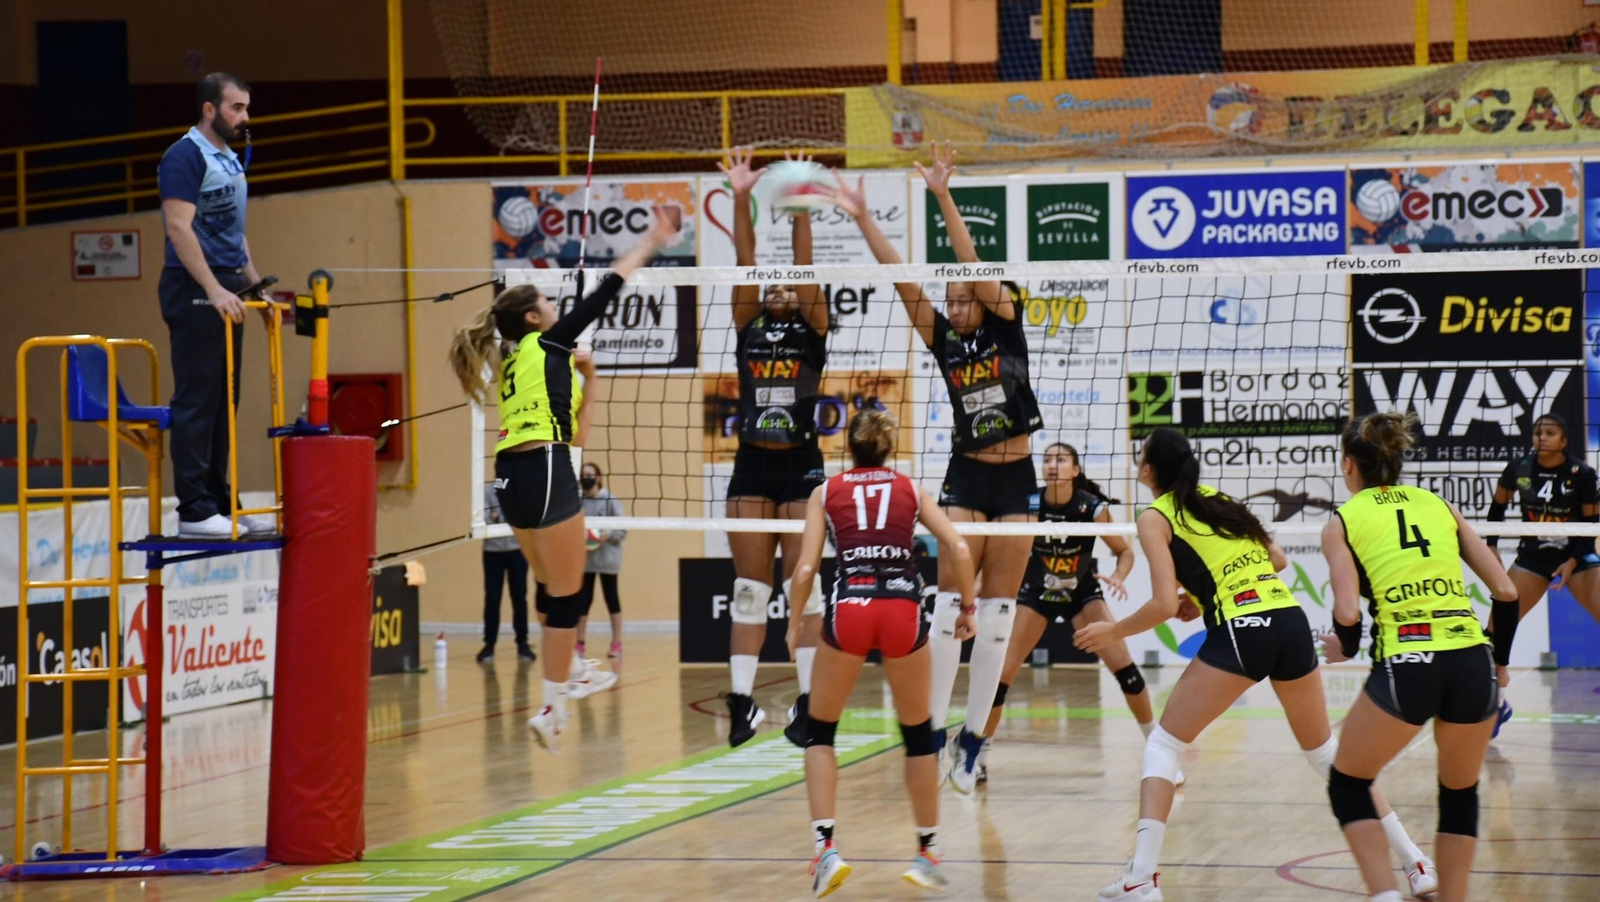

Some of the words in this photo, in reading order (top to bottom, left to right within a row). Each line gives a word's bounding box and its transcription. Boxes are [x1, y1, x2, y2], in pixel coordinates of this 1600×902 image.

[1201, 186, 1338, 219] JUVASA
[1401, 189, 1525, 221] emec
[540, 207, 649, 236] emec
[1202, 221, 1340, 245] PACKAGING
[1037, 232, 1099, 245] SEVILLA
[934, 264, 1005, 278] rfevb.com
[1127, 261, 1200, 274] rfevb.com
[1326, 257, 1401, 270] rfevb.com
[1534, 251, 1600, 265] rfevb.co
[746, 268, 815, 280] rfevb.com
[1439, 295, 1573, 334] Divisa
[749, 360, 801, 379] WAY
[1210, 367, 1327, 393] Borda
[1363, 368, 1572, 437] WAY
[1374, 491, 1410, 506] BRUN
[1537, 480, 1554, 503] 4
[852, 482, 893, 531] 17
[1396, 508, 1432, 558] 4
[1384, 577, 1468, 604] GRIFOLS
[167, 593, 229, 621] TRANSPORTES
[1233, 616, 1272, 629] DSV
[39, 630, 109, 687] Caasol
[167, 623, 267, 676] Valiente
